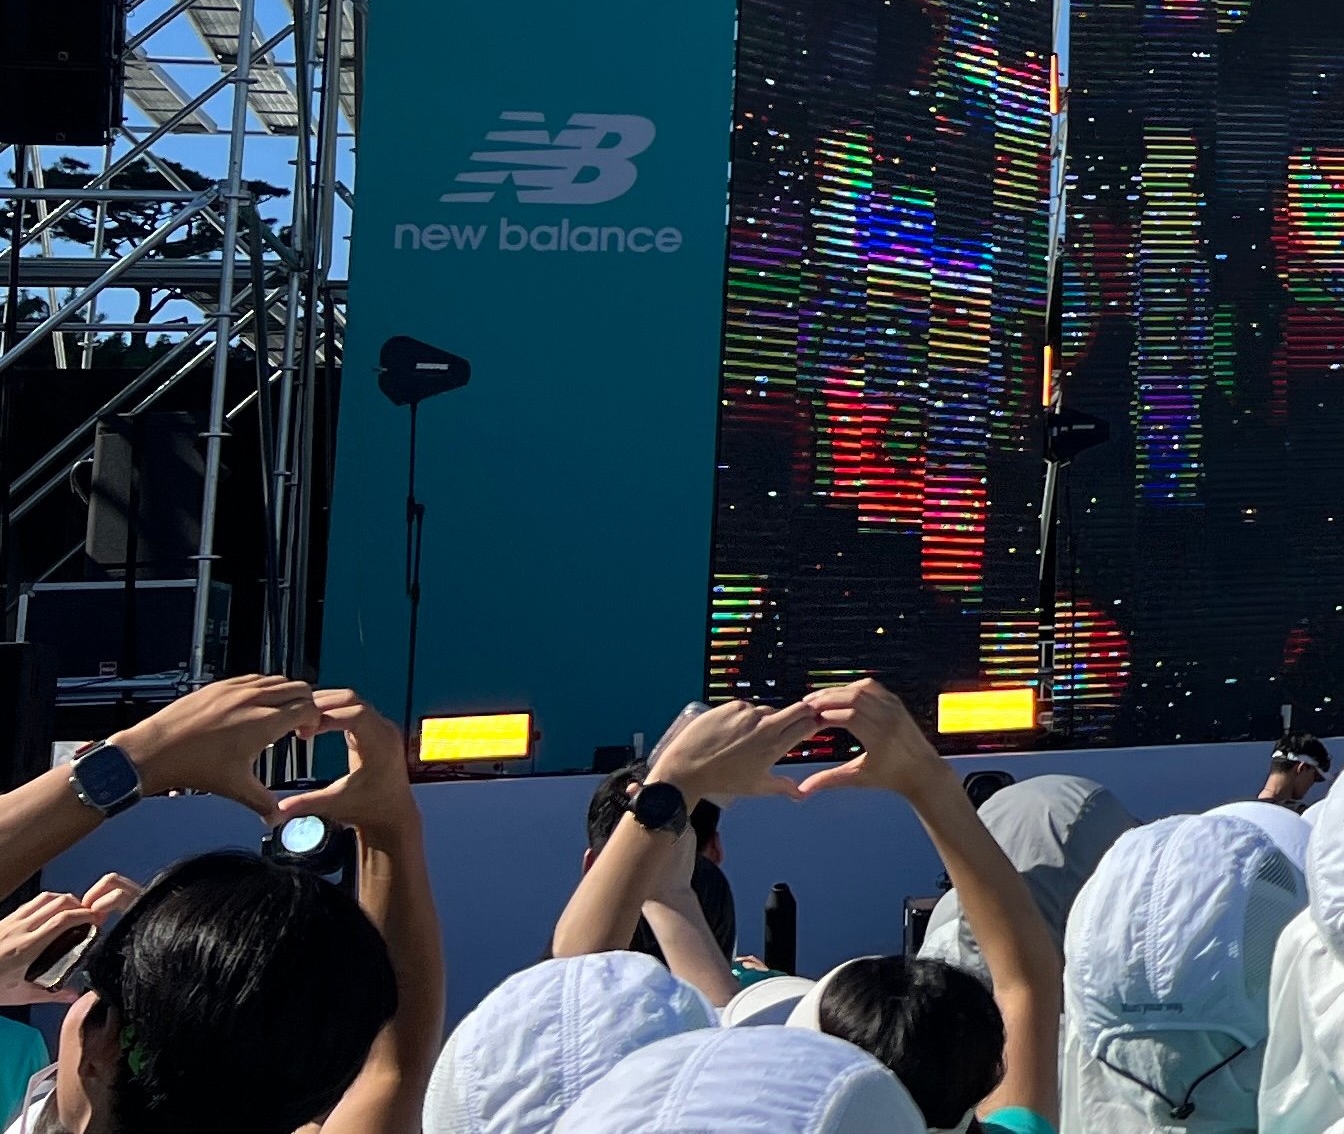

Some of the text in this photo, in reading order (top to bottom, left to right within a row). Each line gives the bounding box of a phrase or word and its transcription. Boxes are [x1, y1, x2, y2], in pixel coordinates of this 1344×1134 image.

[439, 111, 656, 205] NB
[394, 217, 683, 253] new balance
